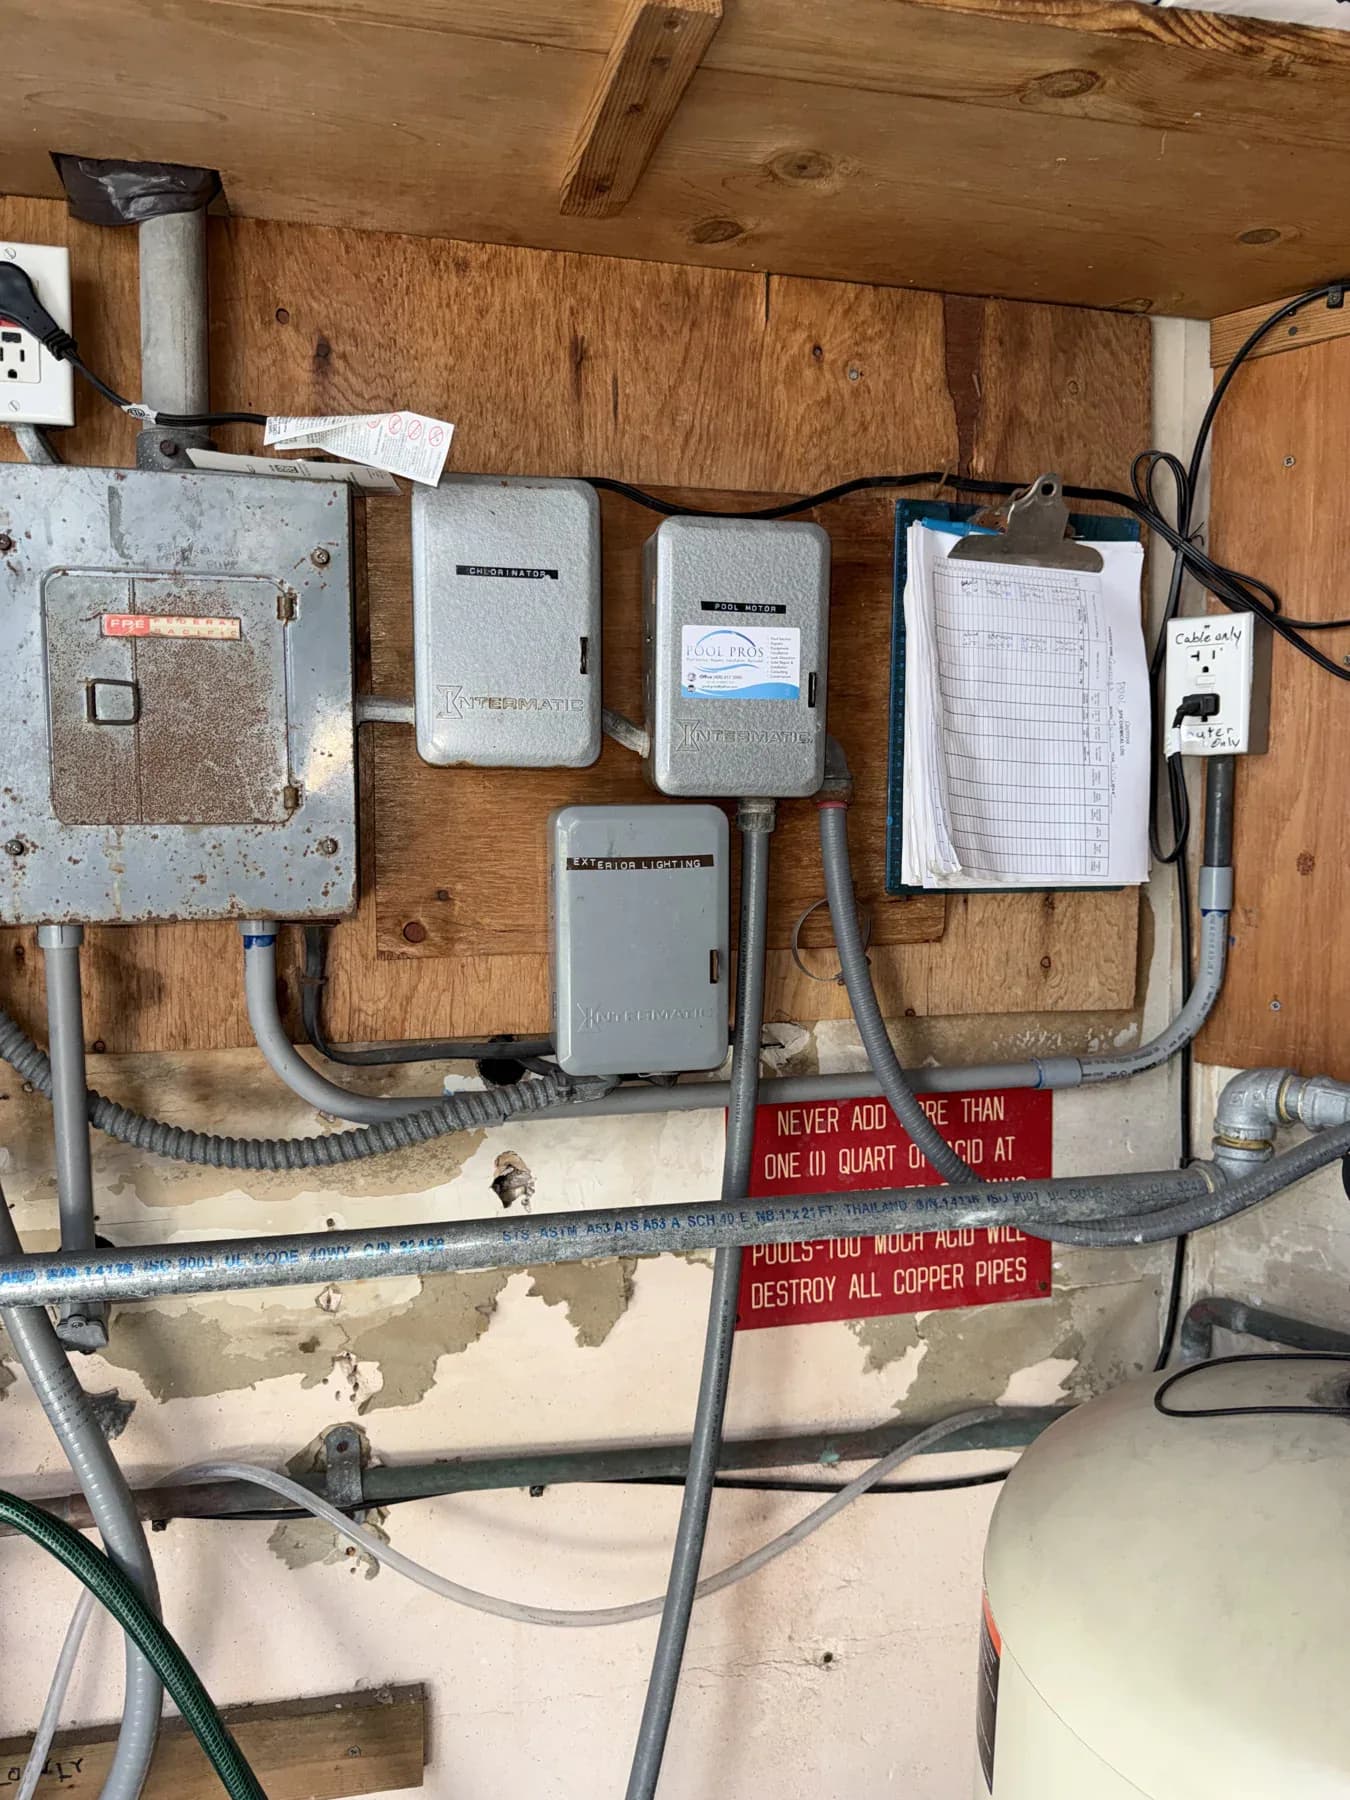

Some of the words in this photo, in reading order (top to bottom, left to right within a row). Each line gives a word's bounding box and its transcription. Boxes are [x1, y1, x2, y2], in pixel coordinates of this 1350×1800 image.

[468, 567, 547, 579] CHLORINATOR
[714, 603, 739, 612] POOL
[745, 605, 778, 613] MOTOR
[110, 618, 145, 630] FPE
[153, 617, 238, 627] FEDERAL
[1175, 631, 1212, 645] Cable
[1214, 626, 1243, 649] only
[686, 645, 723, 658] POOL
[729, 646, 765, 659] PROS
[436, 685, 585, 720] INTERMATIC
[676, 718, 811, 751] INTERMATIC
[573, 857, 637, 870] EXTERIOR
[641, 859, 702, 870] LIGHTING
[777, 1106, 839, 1137] NEVER
[851, 1104, 887, 1131] ADD
[960, 1096, 1005, 1123] THAN
[764, 1151, 802, 1181] ONE
[838, 1144, 897, 1175] QUART
[993, 1136, 1016, 1163] AT
[540, 1225, 578, 1239] ASTM
[586, 1221, 611, 1235] A53
[642, 1218, 667, 1232] A53
[671, 1217, 681, 1230] A
[845, 1200, 908, 1216] THAILAND
[1012, 1190, 1039, 1204] 9001
[874, 1234, 924, 1255] MUCH
[935, 1227, 976, 1249] ACID
[987, 1225, 1027, 1245] WILL
[179, 1256, 213, 1270] 9001
[254, 1249, 299, 1266] CODE
[751, 1275, 837, 1310] DESTROY
[848, 1271, 882, 1300] ALL
[893, 1263, 964, 1296] COPPER
[975, 1256, 1027, 1287] PIPES
